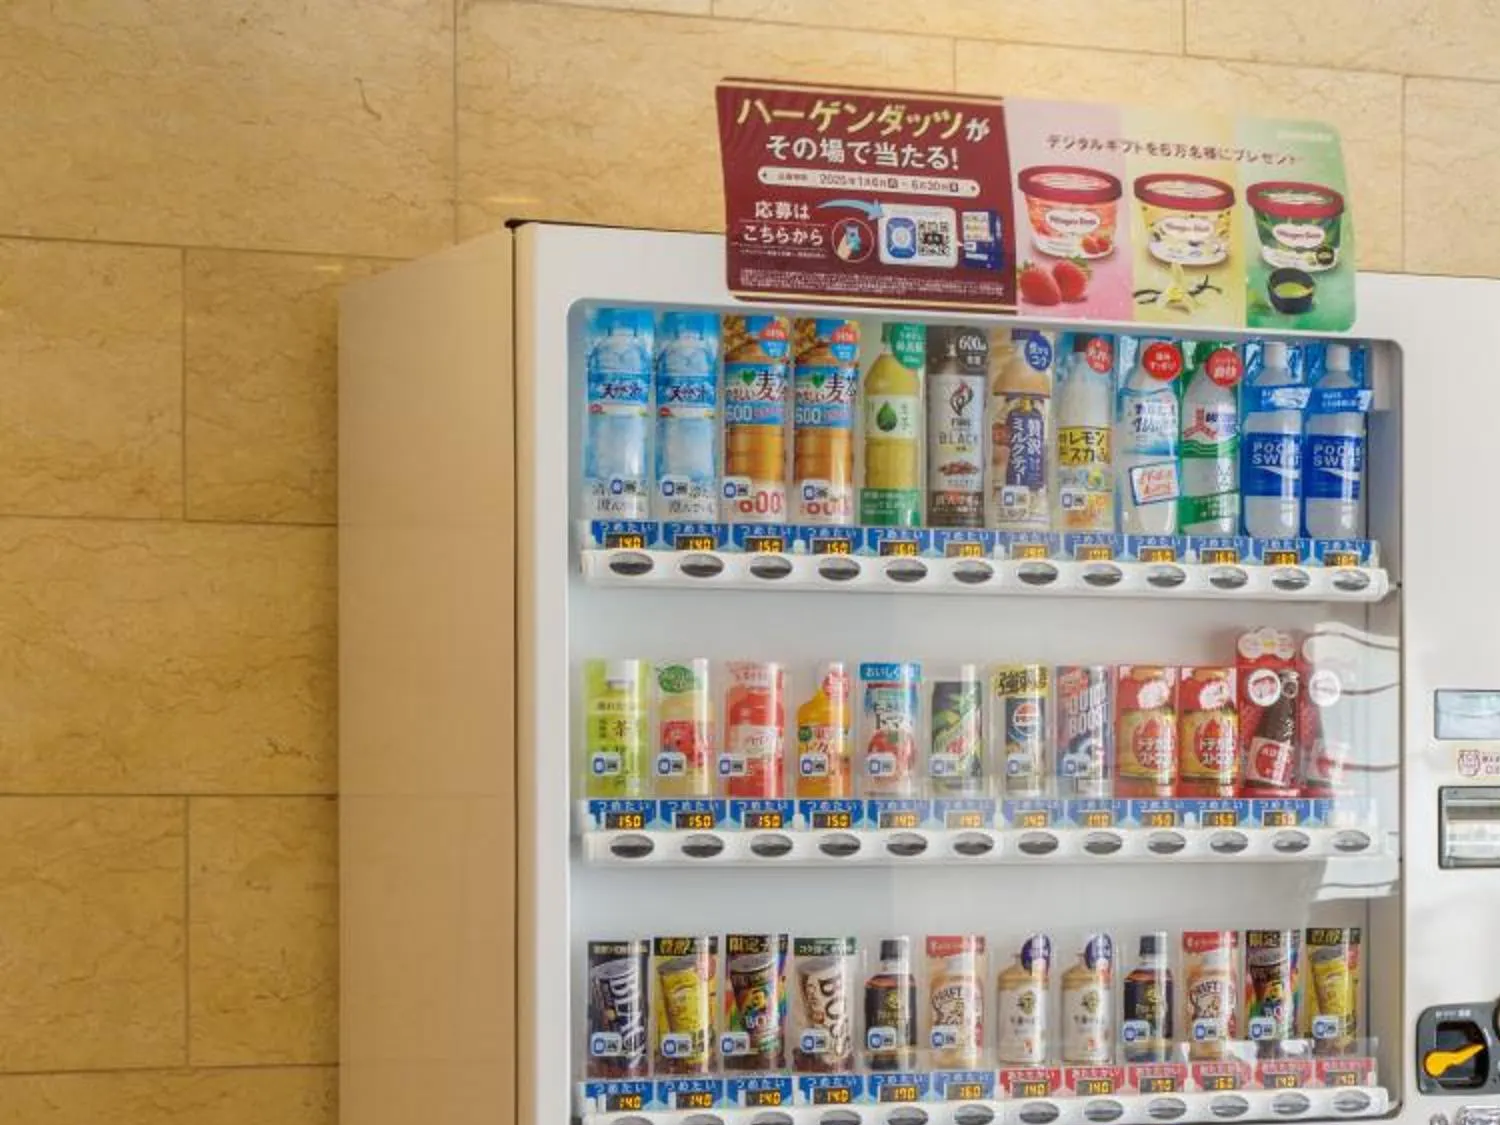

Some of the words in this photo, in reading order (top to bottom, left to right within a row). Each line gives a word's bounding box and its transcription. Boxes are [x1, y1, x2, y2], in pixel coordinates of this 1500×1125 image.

[737, 98, 990, 142] ハーゲンダッツが
[766, 135, 959, 170] その場で当たる!
[755, 200, 810, 220] 応募は
[743, 225, 824, 245] こちらから
[619, 815, 641, 826] 150
[689, 816, 711, 827] 150
[759, 815, 780, 827] 150
[827, 815, 849, 827] 150
[595, 1083, 647, 1093] つめたい
[735, 1079, 785, 1089] つめたい
[619, 1096, 641, 1108] 140
[689, 1094, 711, 1107] 140
[759, 1092, 780, 1104] 140
